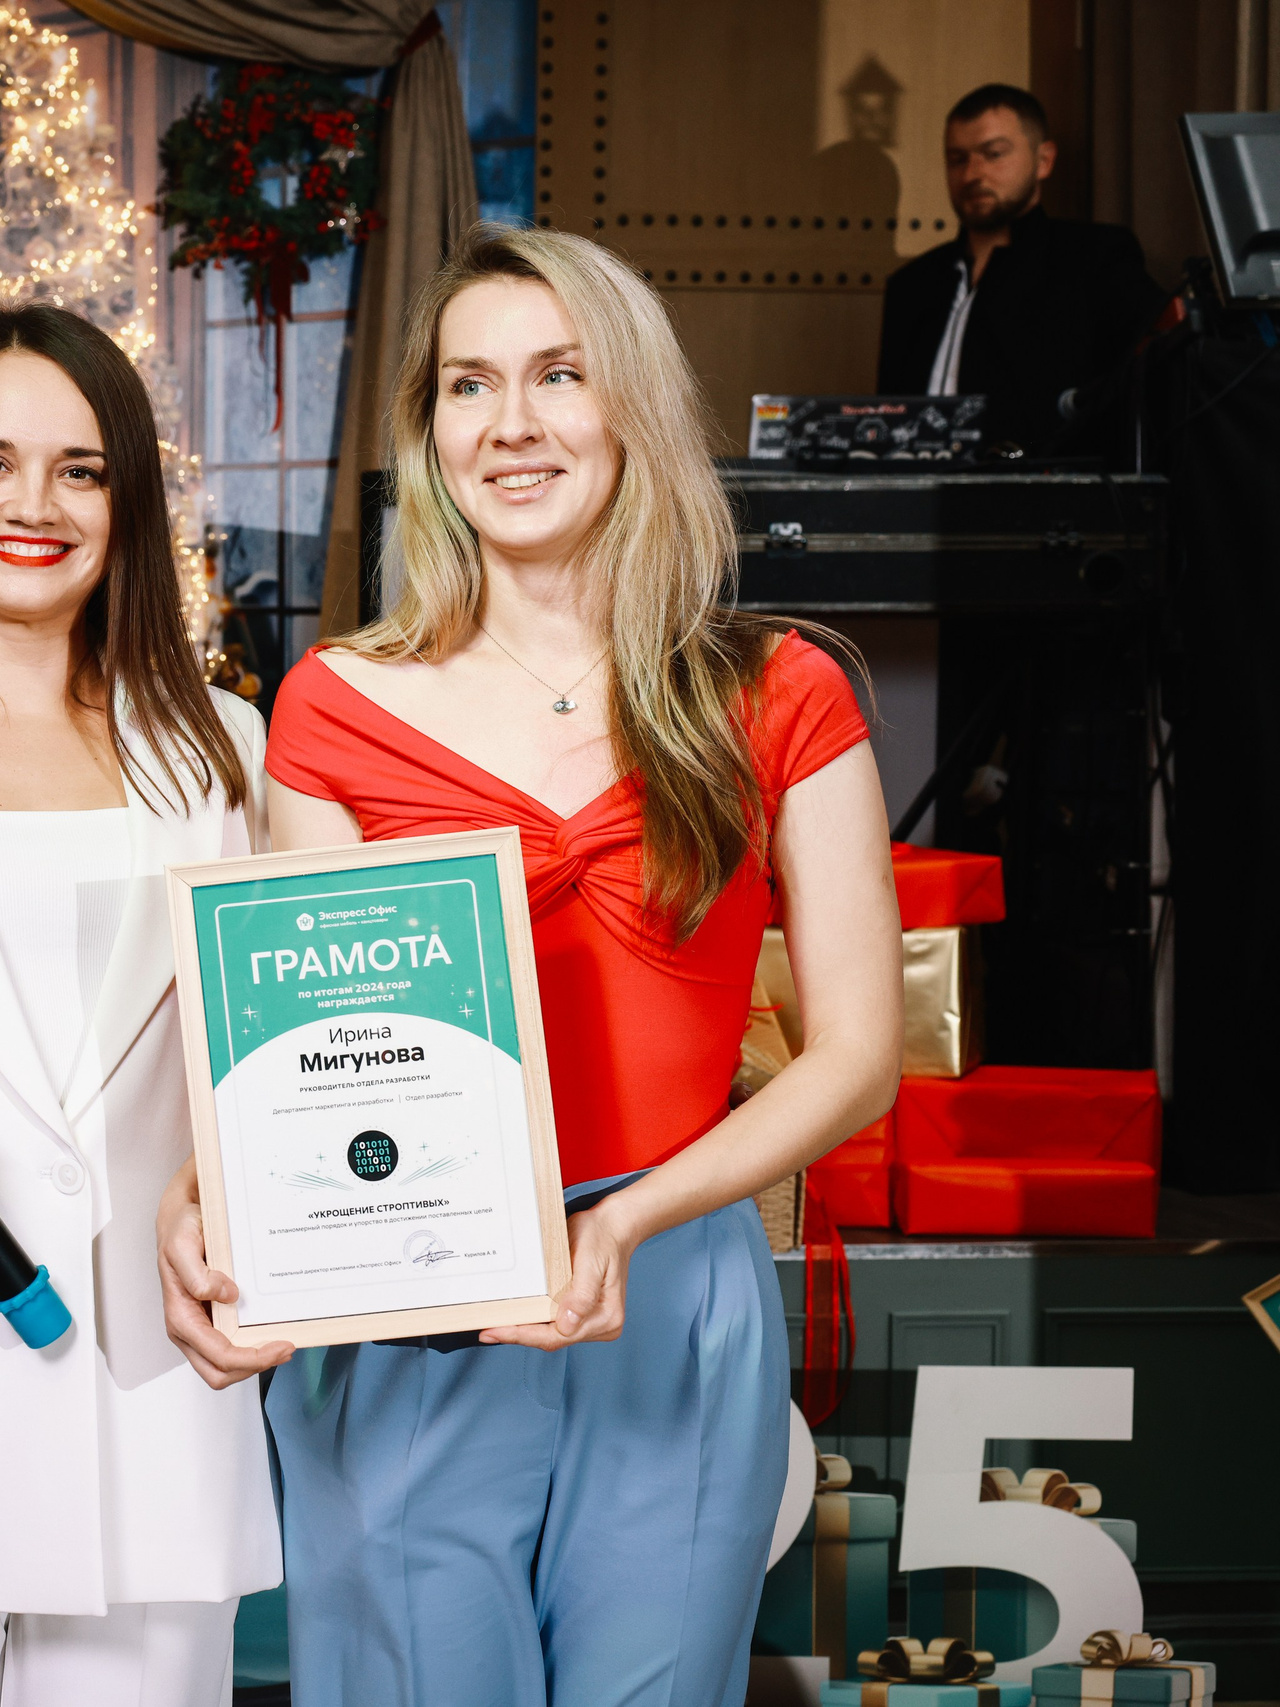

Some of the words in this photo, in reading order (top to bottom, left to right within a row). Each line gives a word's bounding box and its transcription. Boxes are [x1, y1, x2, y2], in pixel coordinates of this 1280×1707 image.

[318, 908, 367, 921] Экспресс
[368, 905, 398, 917] Офис
[250, 933, 453, 985] ГРАМОТА
[298, 990, 312, 1000] по
[313, 985, 354, 997] итогам
[355, 982, 384, 993] 2024
[385, 979, 412, 992] года
[317, 993, 395, 1009] награждается
[328, 1024, 392, 1047] Ирина
[299, 1045, 425, 1073] Мигунова
[299, 1081, 355, 1093] РУКОВОДИТЕЛЬ
[356, 1078, 384, 1088] ОТДЕЛА
[385, 1074, 431, 1085] РАЗРАБОТКИ
[405, 1094, 425, 1102] Отдел
[426, 1091, 463, 1100] разработки
[272, 1105, 314, 1115] Департамент
[315, 1102, 351, 1111] маркетинга
[357, 1097, 394, 1107] разработки
[353, 1139, 389, 1150] 101010
[355, 1147, 390, 1158] 010101
[355, 1156, 391, 1166] 101010
[356, 1164, 392, 1175] 010101
[308, 1206, 375, 1220] «УКРОЩЕНИЕ
[376, 1198, 450, 1213] СТРОПТИВЫХ»
[277, 1225, 320, 1234] планомерный
[321, 1222, 348, 1231] порядок
[354, 1218, 383, 1227] упорство
[389, 1214, 427, 1224] достижении
[428, 1210, 472, 1219] поставленных
[473, 1207, 493, 1215] целей
[269, 1269, 304, 1278] Генеральный
[304, 1266, 329, 1275] директор
